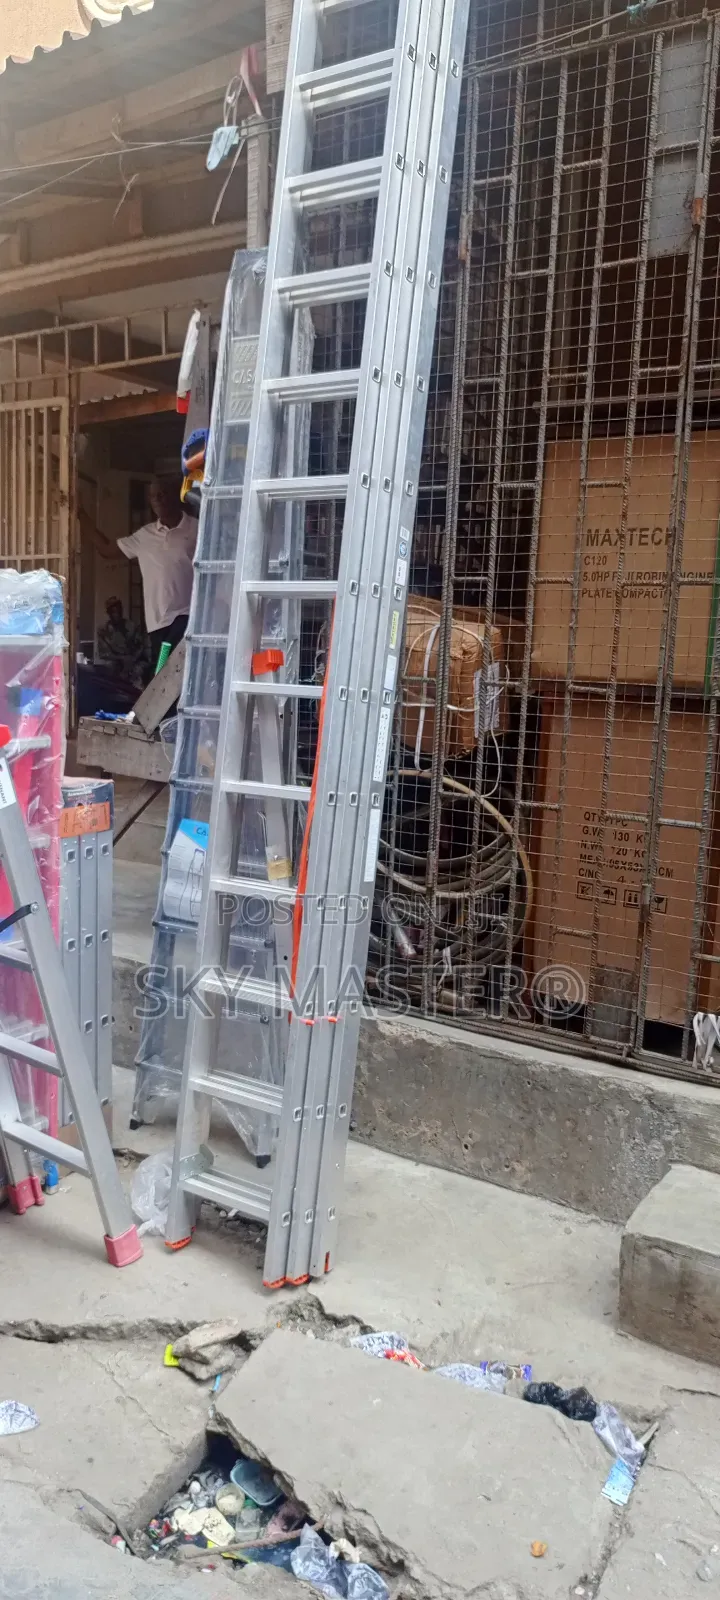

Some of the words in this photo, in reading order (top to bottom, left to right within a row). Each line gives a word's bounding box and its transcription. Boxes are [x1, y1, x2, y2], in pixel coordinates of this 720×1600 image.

[583, 554, 607, 566] C120
[582, 571, 610, 583] 5.0HP
[581, 587, 612, 599] PLATE
[612, 829, 630, 842] 130
